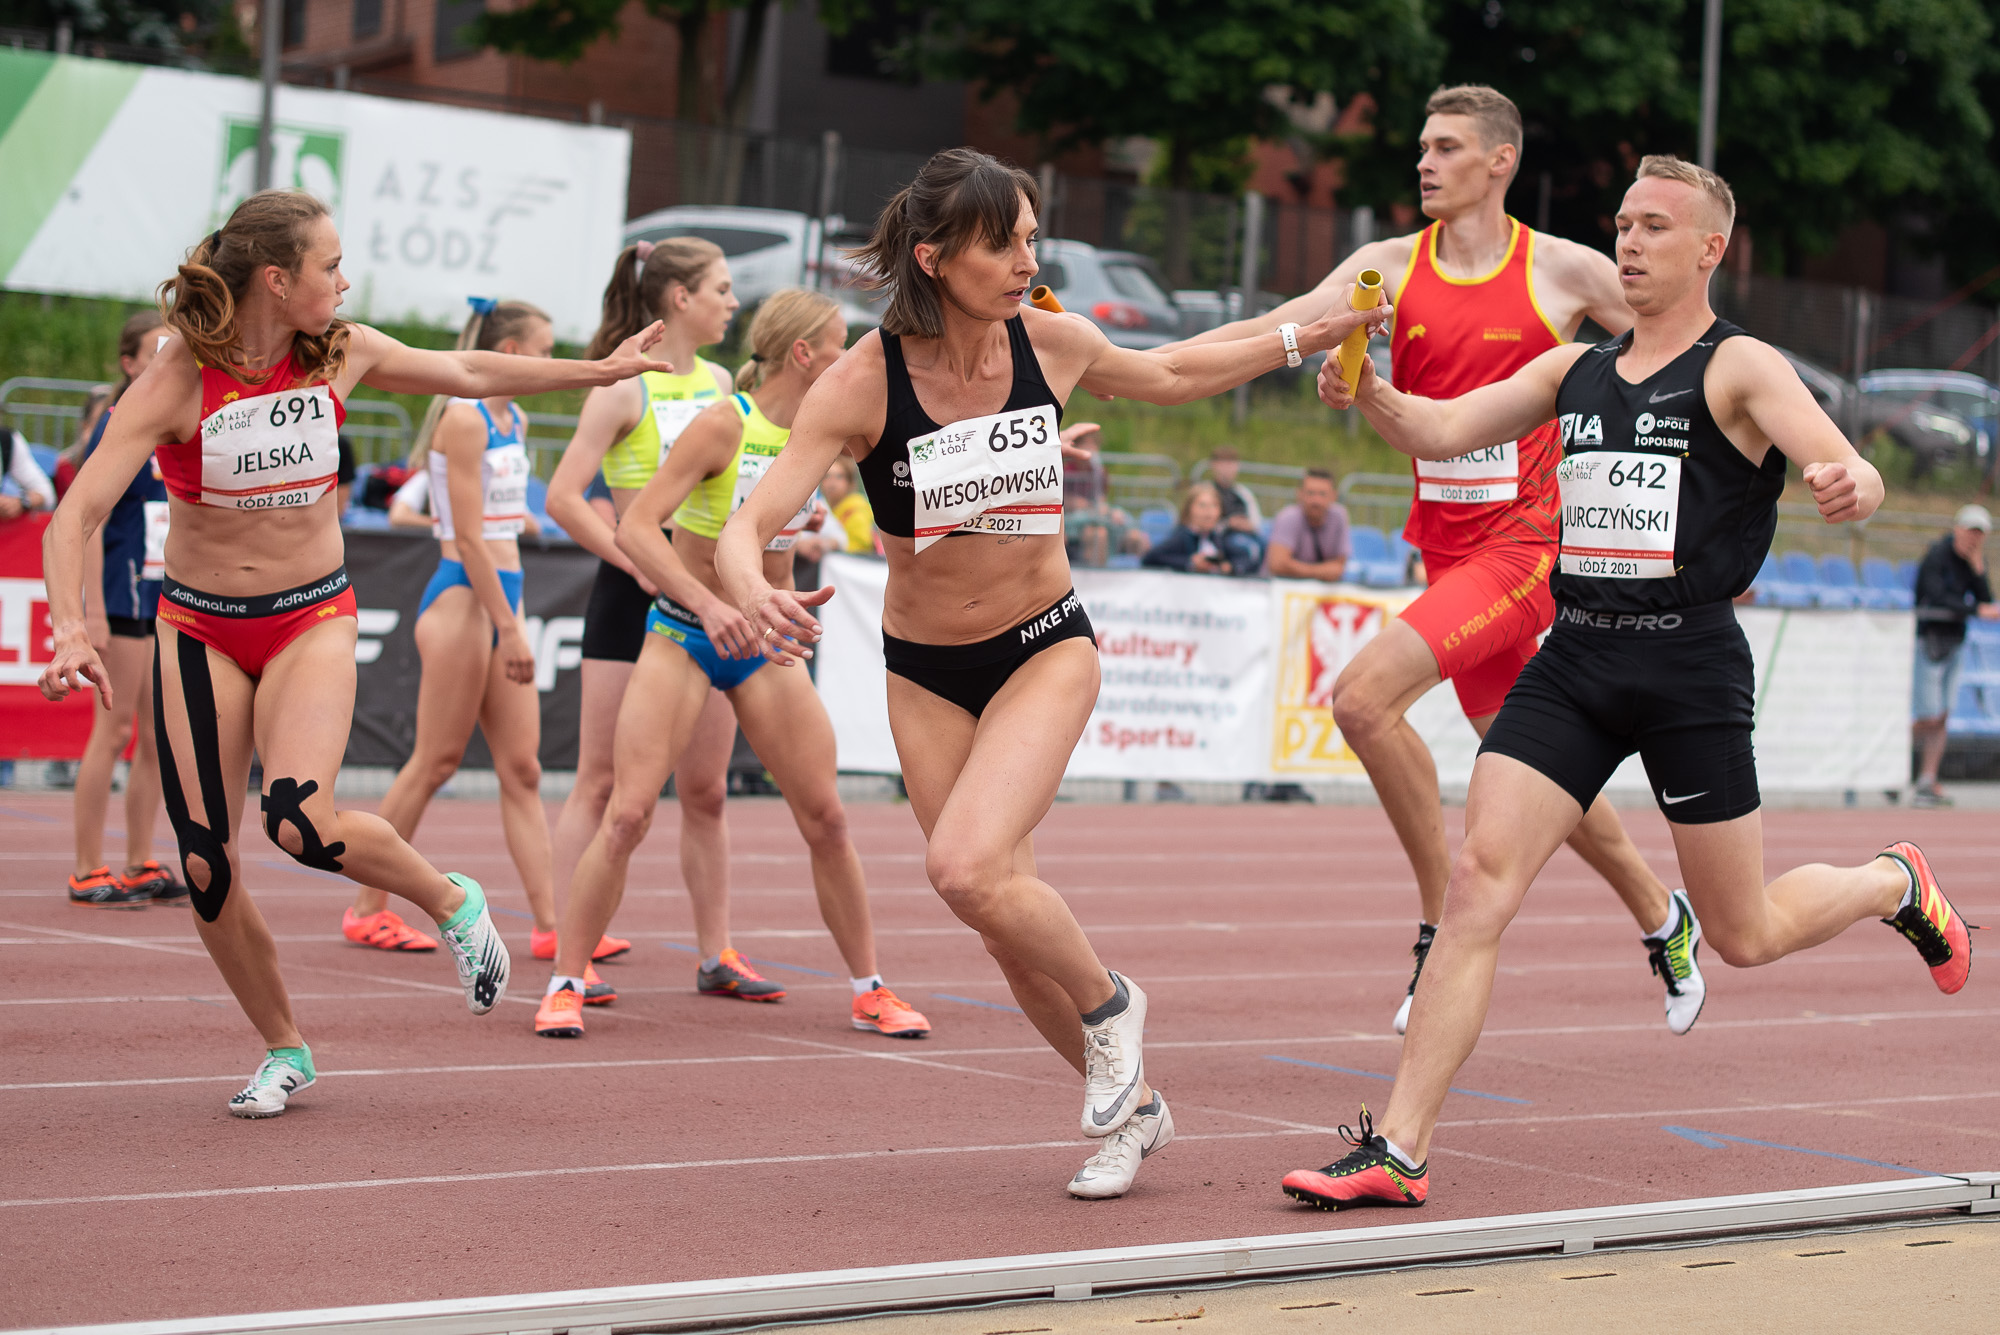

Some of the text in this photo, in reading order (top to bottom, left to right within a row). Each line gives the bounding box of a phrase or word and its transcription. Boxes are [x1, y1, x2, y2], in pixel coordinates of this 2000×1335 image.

[373, 161, 480, 210] AZS
[228, 411, 247, 421] AZS
[269, 395, 325, 427] 691
[988, 415, 1048, 452] 653
[1656, 419, 1690, 431] OPOLE
[939, 433, 962, 445] AZS
[1640, 436, 1689, 450] OPOLSKIE
[232, 442, 314, 475] JELSKA
[922, 465, 1059, 511] WESOŁOWSKA
[1608, 460, 1667, 489] 642
[236, 492, 309, 508] ŁÓDŹ 2021
[1441, 486, 1490, 500] ŁÓDŹ 2021
[986, 517, 1022, 531] 2021
[1565, 503, 1669, 532] JURCZYŃSKI
[1579, 557, 1638, 575] ŁÓDŹ 2021
[1020, 608, 1062, 645] NIKE
[1442, 633, 1461, 651] KS
[1459, 595, 1513, 640] PODLASIE
[1559, 606, 1683, 631] NIKE PRO
